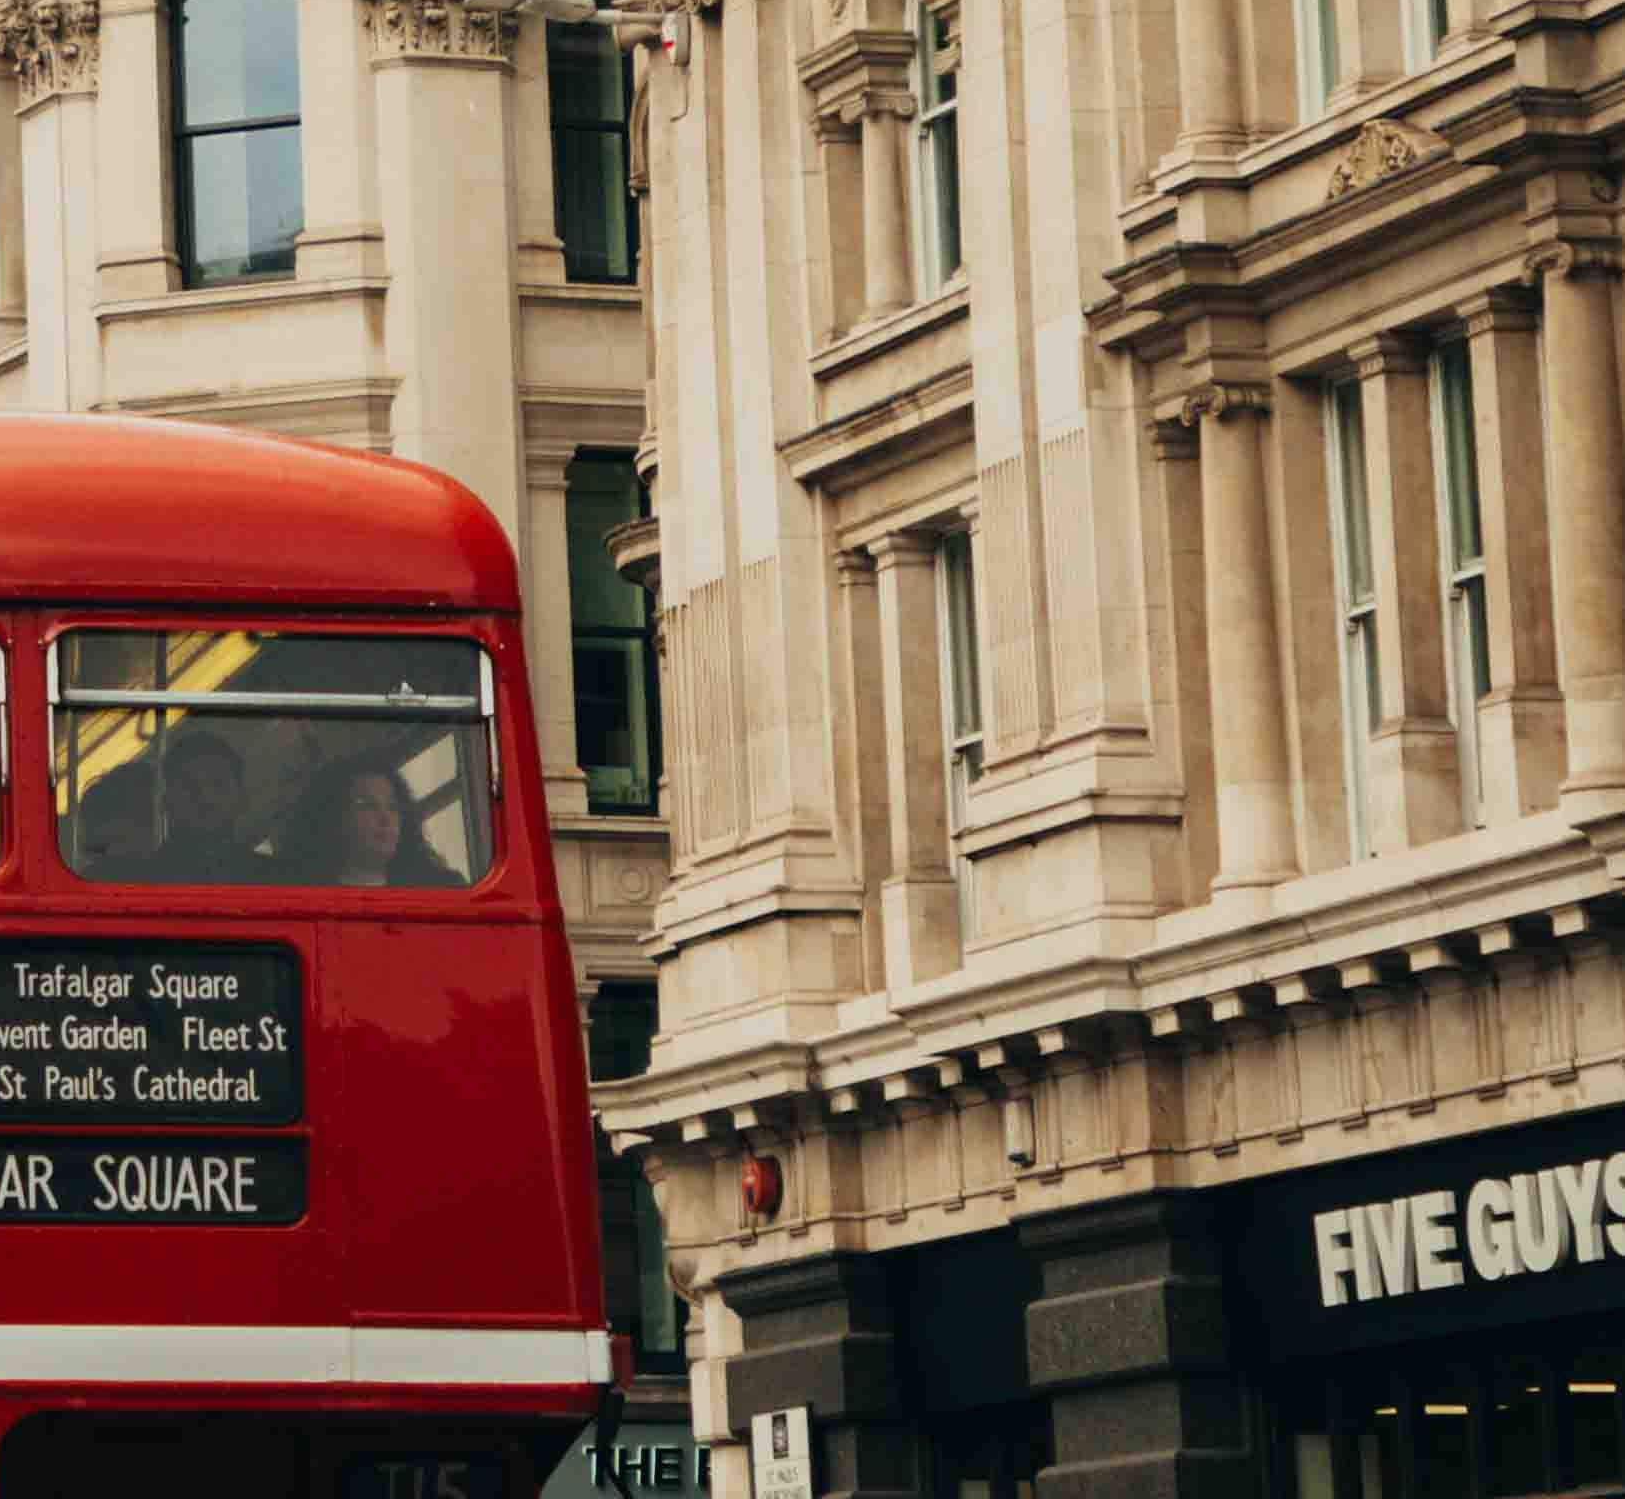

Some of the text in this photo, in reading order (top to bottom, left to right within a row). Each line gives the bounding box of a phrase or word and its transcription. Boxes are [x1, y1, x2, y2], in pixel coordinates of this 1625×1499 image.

[13, 963, 239, 1009] Trafalgar Square
[61, 1014, 147, 1051] Garden
[183, 1016, 252, 1052] Fleet
[257, 1016, 287, 1052] St
[45, 1065, 116, 1101] Paul's
[133, 1064, 260, 1102] Cathedral
[93, 1154, 258, 1212] SQUARE
[1313, 1151, 1625, 1308] FIVE GUYS
[581, 1445, 683, 1487] THE
